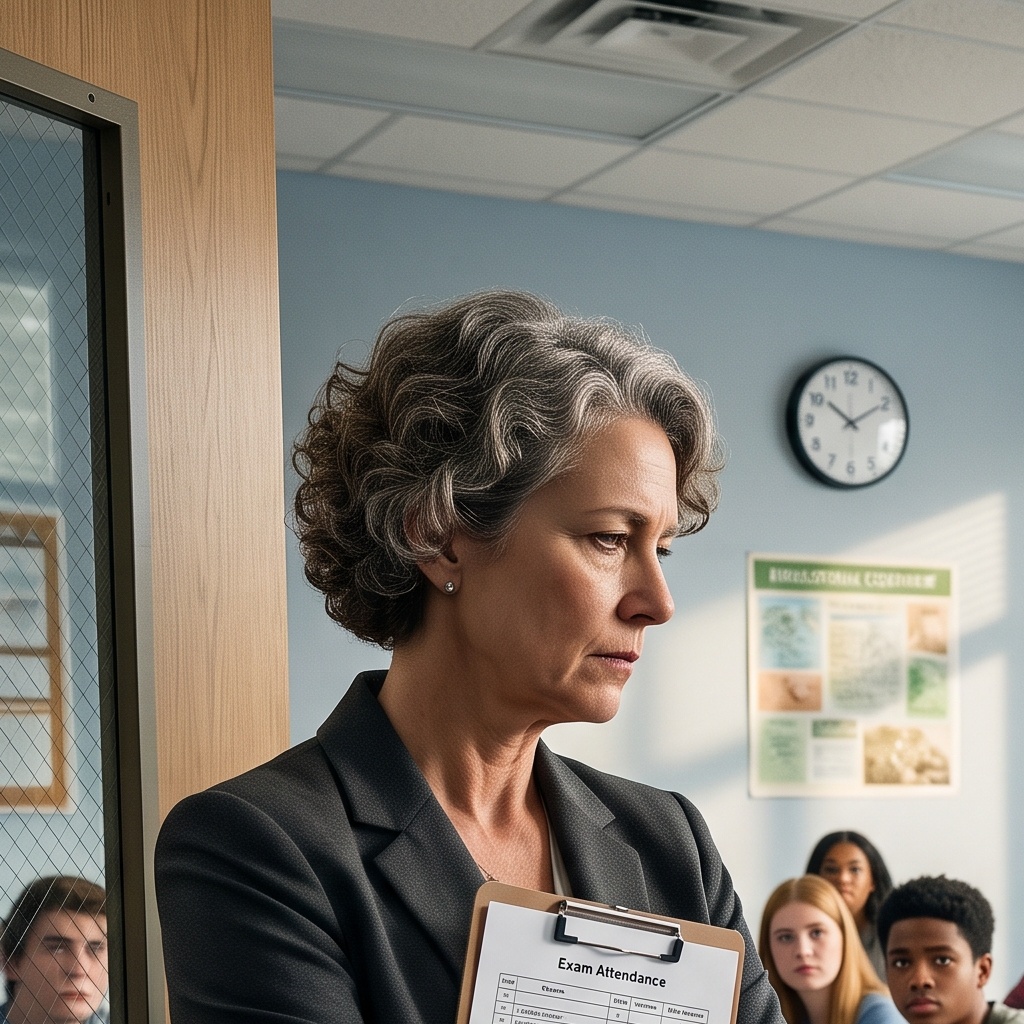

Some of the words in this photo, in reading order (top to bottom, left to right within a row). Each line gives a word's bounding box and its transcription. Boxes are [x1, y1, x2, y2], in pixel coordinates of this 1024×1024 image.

[844, 370, 858, 386] 12
[810, 391, 824, 407] 10
[881, 397, 890, 411] 2
[828, 453, 836, 469] 7
[846, 462, 855, 475] 6
[867, 456, 876, 471] 5
[558, 957, 593, 975] Exam
[596, 964, 667, 988] Attendance
